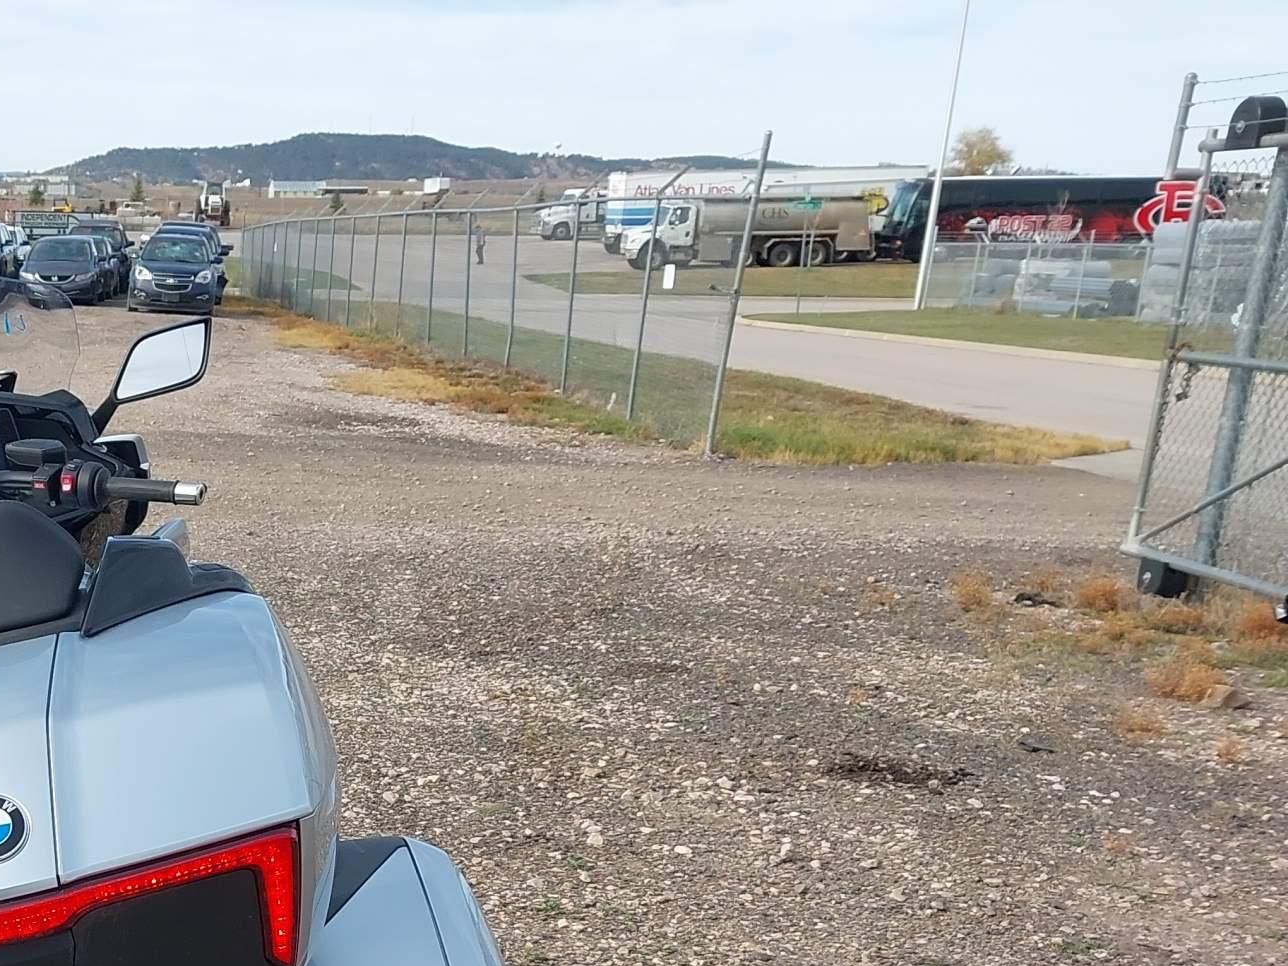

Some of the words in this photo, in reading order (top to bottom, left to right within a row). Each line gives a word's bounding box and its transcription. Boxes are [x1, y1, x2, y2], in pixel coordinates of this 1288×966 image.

[672, 183, 695, 196] Van
[699, 183, 735, 195] Lines
[998, 215, 1048, 234] POST
[1048, 214, 1073, 232] 22
